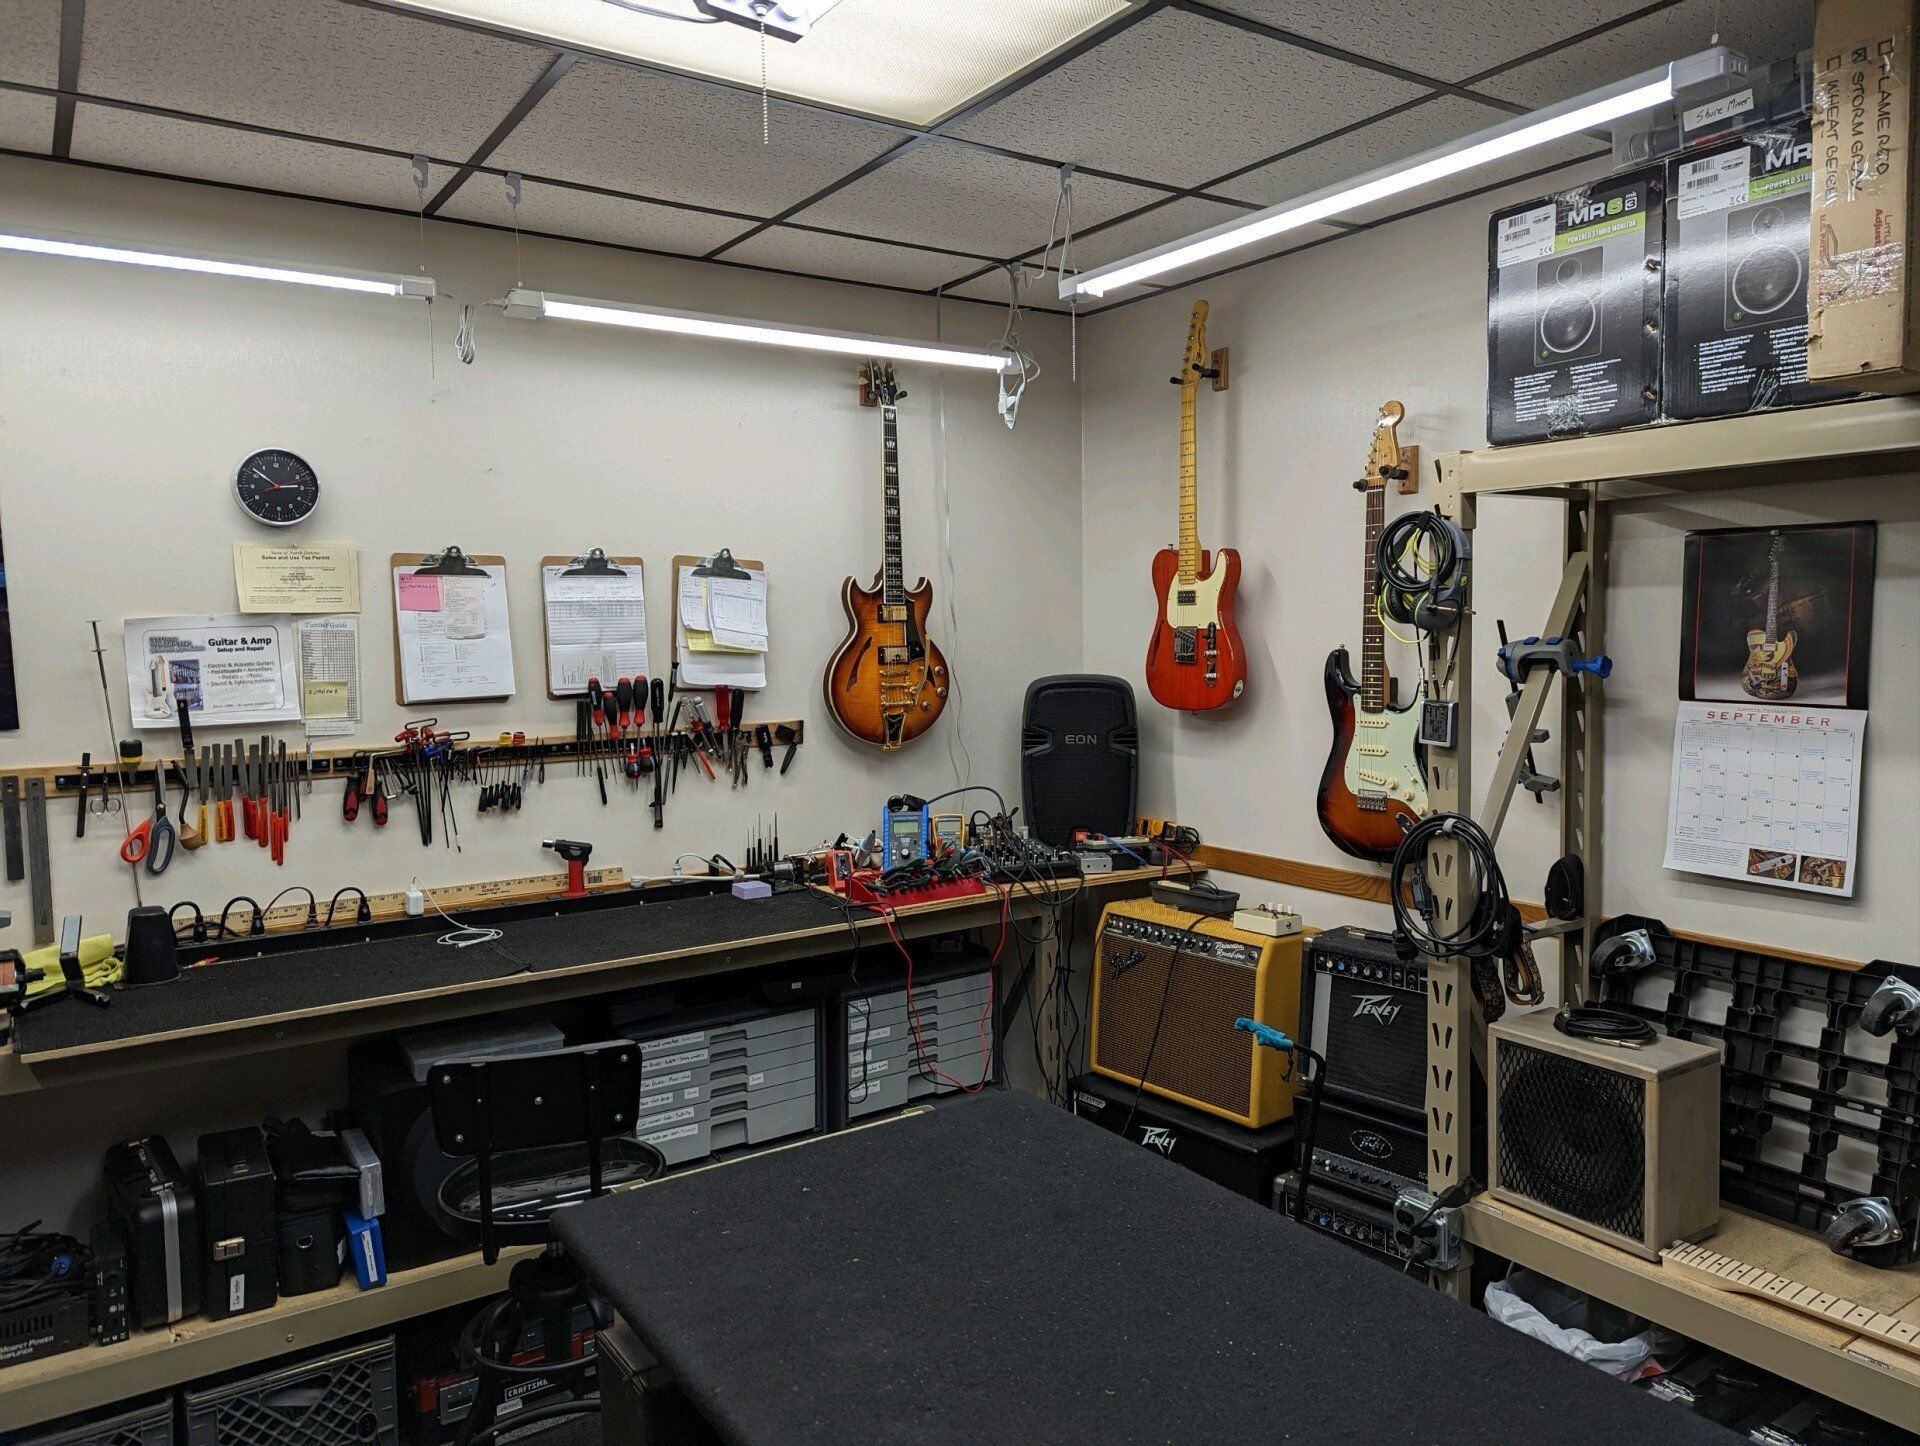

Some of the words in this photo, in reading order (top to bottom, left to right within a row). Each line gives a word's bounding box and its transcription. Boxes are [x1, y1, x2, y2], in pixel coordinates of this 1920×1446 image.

[1826, 79, 1840, 141] WHEAT
[1850, 71, 1865, 137] STORM
[1695, 107, 1724, 123] Shure
[1566, 230, 1592, 244] POWERED
[1592, 226, 1610, 237] STUDIO
[1612, 220, 1637, 232] MONITOR
[304, 620, 328, 630] Tuning
[208, 638, 238, 646] Guitar
[240, 637, 248, 645] &
[250, 637, 272, 646] Amp
[1706, 710, 1831, 726] SEPTEMBER
[1065, 734, 1098, 744] EON
[1214, 941, 1245, 951] Princeton
[1351, 994, 1402, 1025] PEAVEY
[1139, 1125, 1177, 1155] PEAVEY
[28, 1336, 54, 1347] POWER
[508, 1379, 548, 1397] CRAFTSMA
